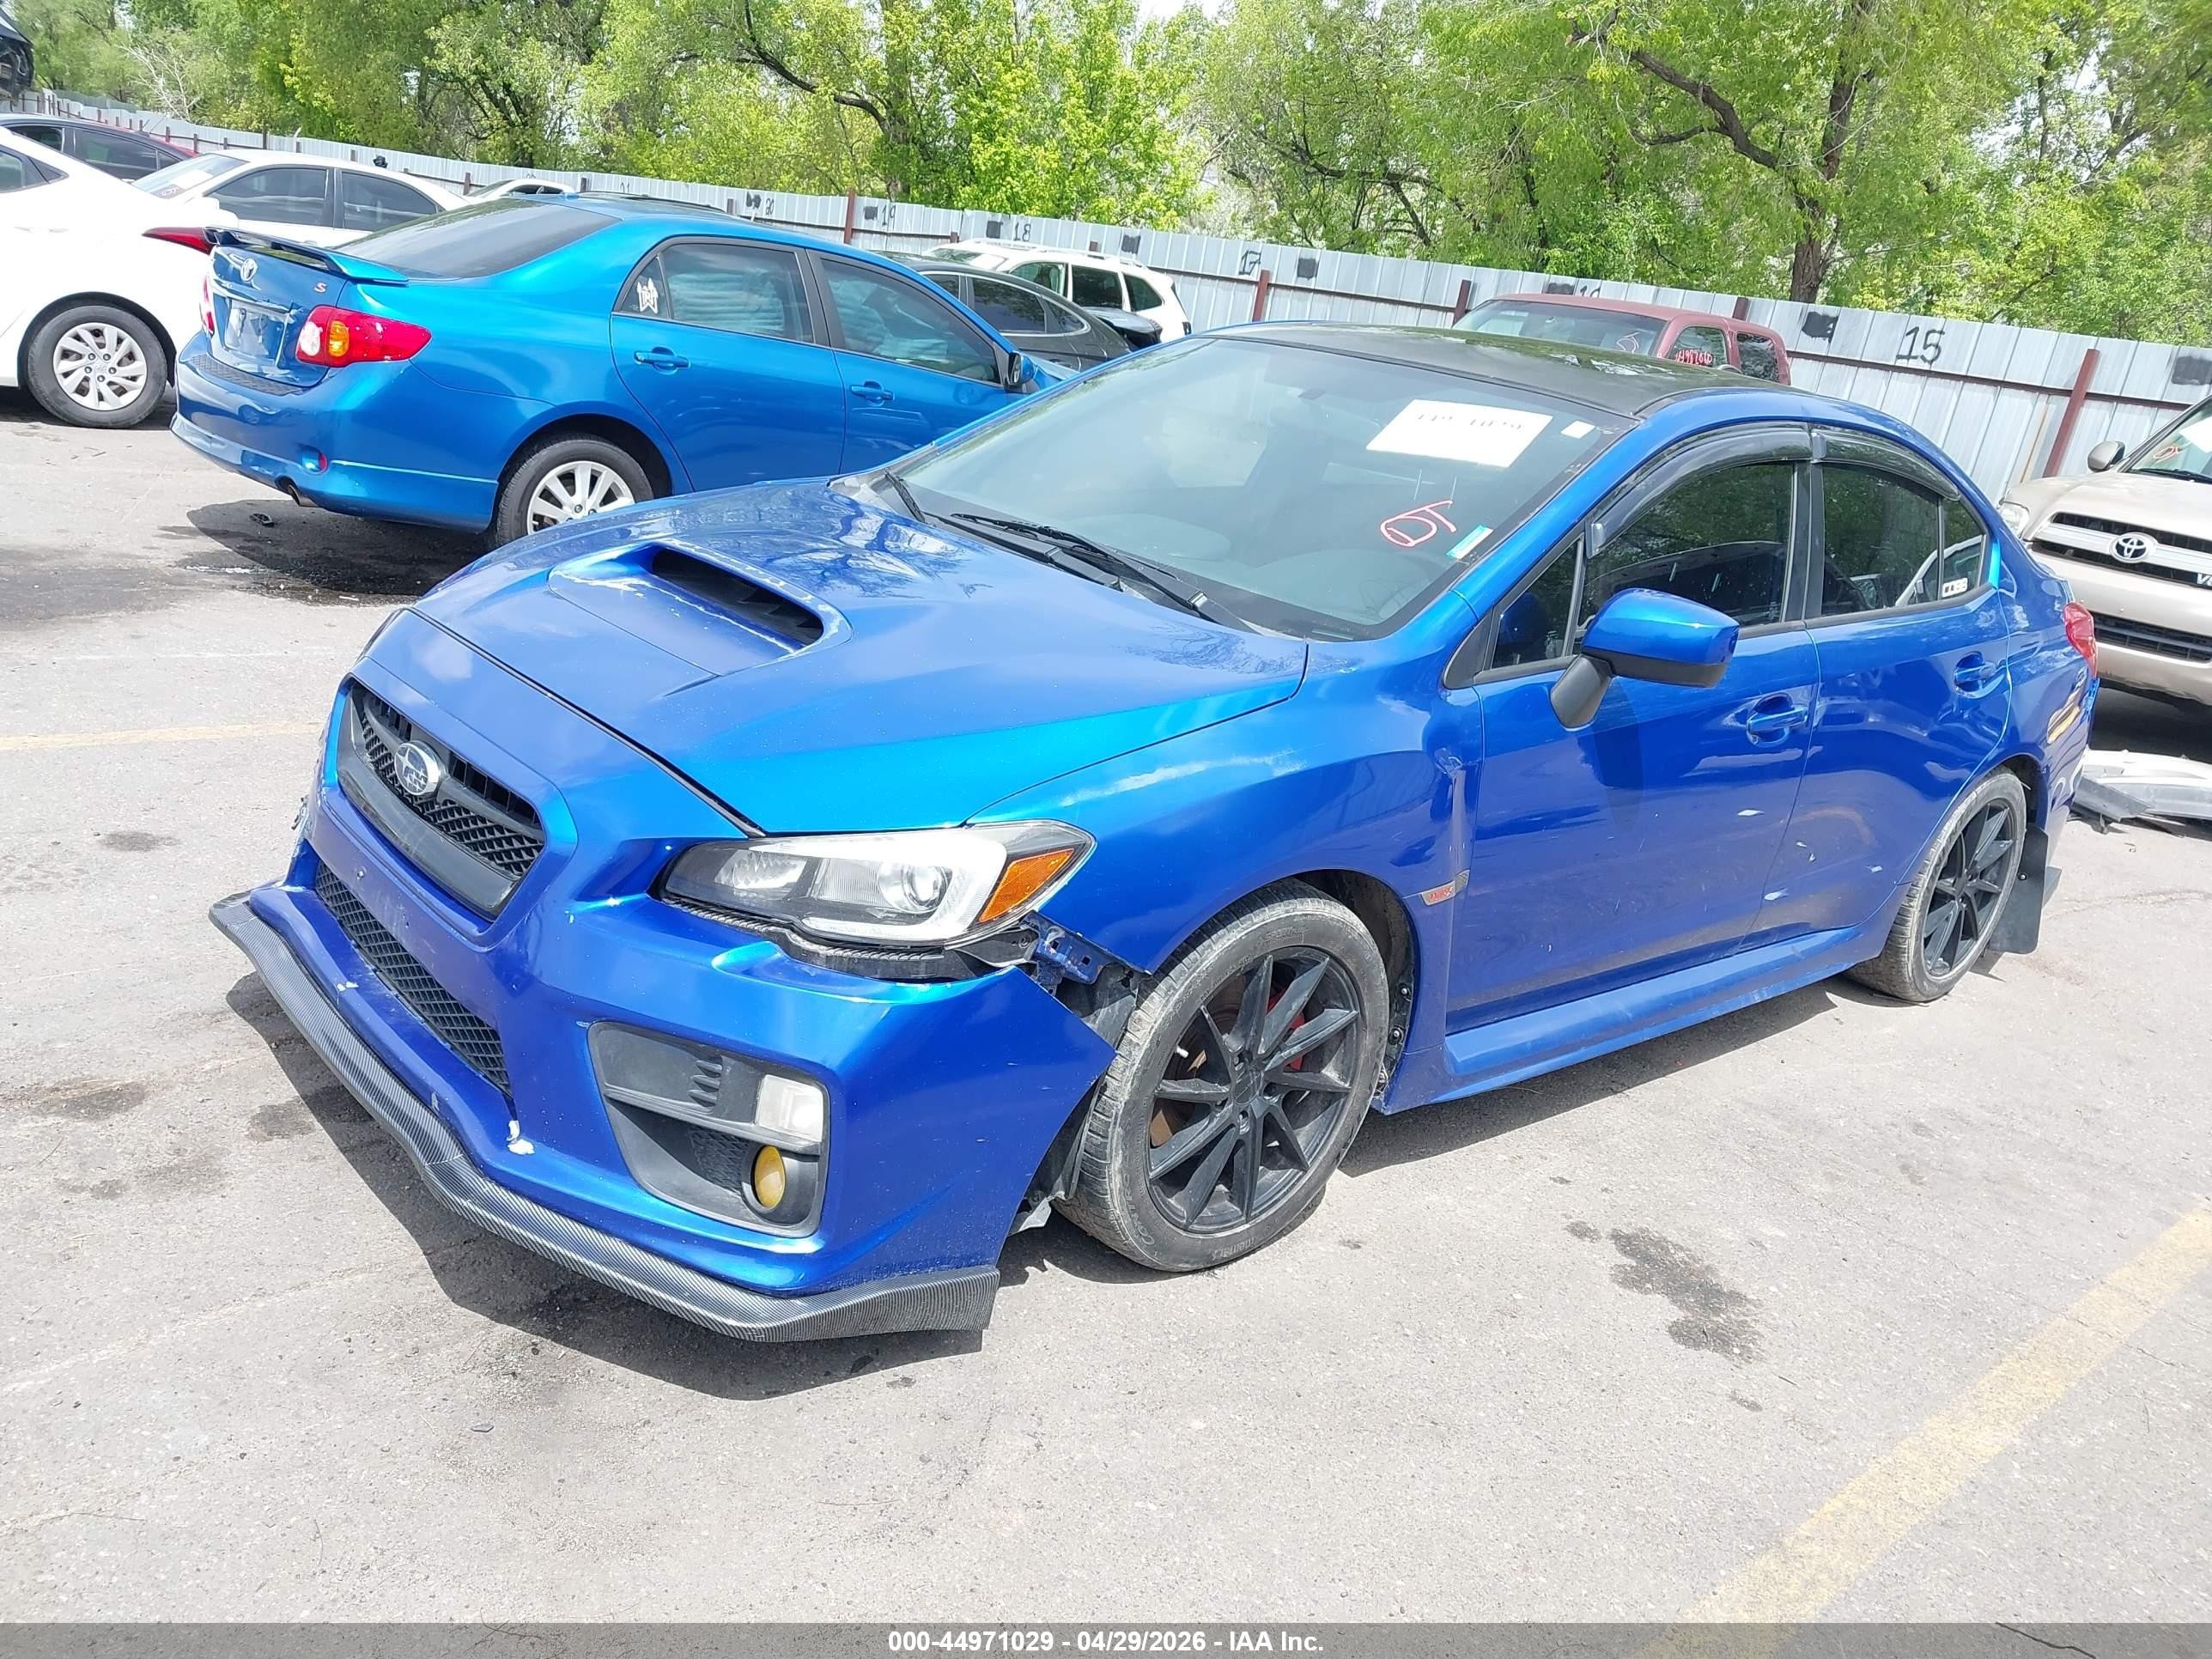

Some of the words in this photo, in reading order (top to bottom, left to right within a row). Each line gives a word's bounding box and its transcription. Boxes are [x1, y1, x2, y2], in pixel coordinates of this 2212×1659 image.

[765, 198, 775, 216] 20
[881, 204, 896, 229] 19
[1013, 221, 1031, 242] 18
[1238, 249, 1261, 276] 17
[313, 282, 327, 293] S
[1895, 325, 1946, 363] 15
